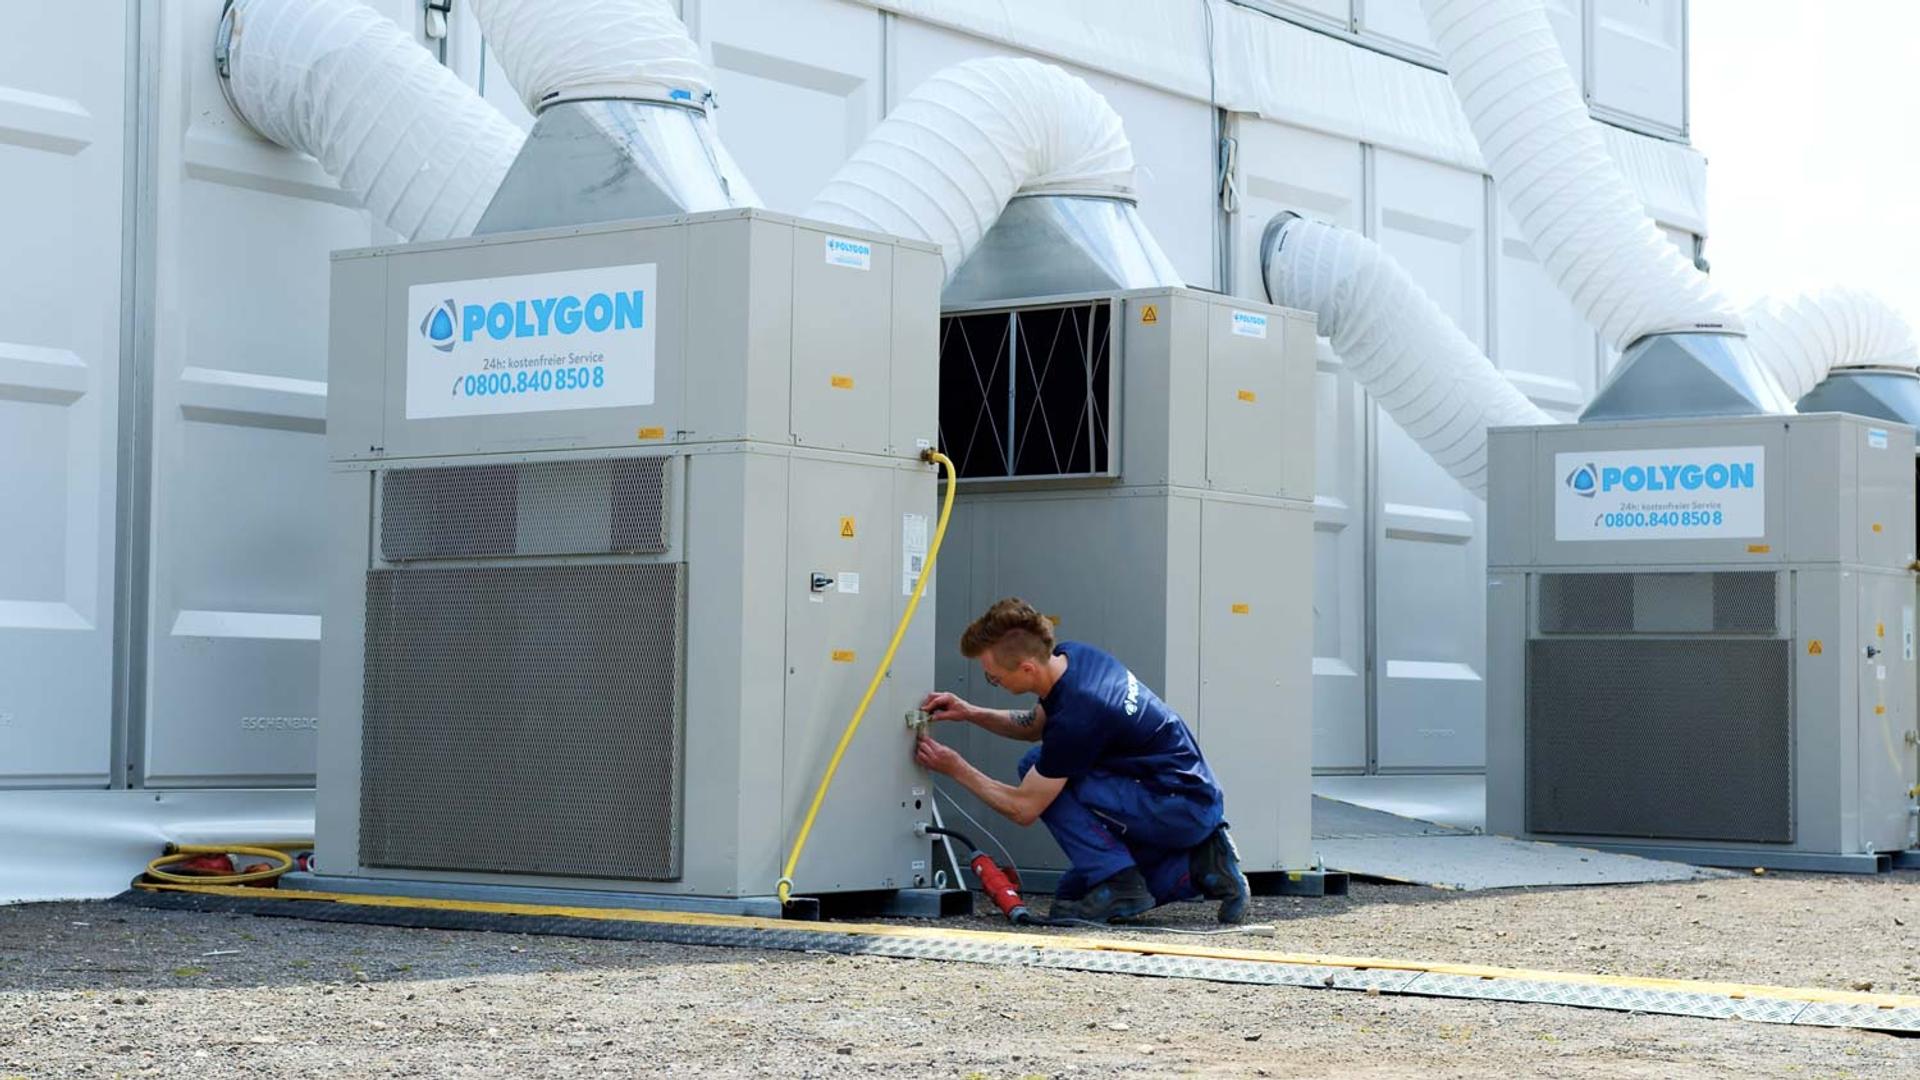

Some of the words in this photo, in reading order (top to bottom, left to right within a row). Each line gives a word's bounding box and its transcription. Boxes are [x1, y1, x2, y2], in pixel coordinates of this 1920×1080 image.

[462, 290, 644, 342] POLYGON
[483, 358, 506, 371] 24h:
[508, 354, 566, 369] kostenfreier
[568, 352, 605, 365] Service
[1602, 463, 1754, 492] POLYGON
[1641, 502, 1690, 511] kostenfreier
[1691, 501, 1721, 510] Service
[242, 716, 318, 729] ESCHENBAC
